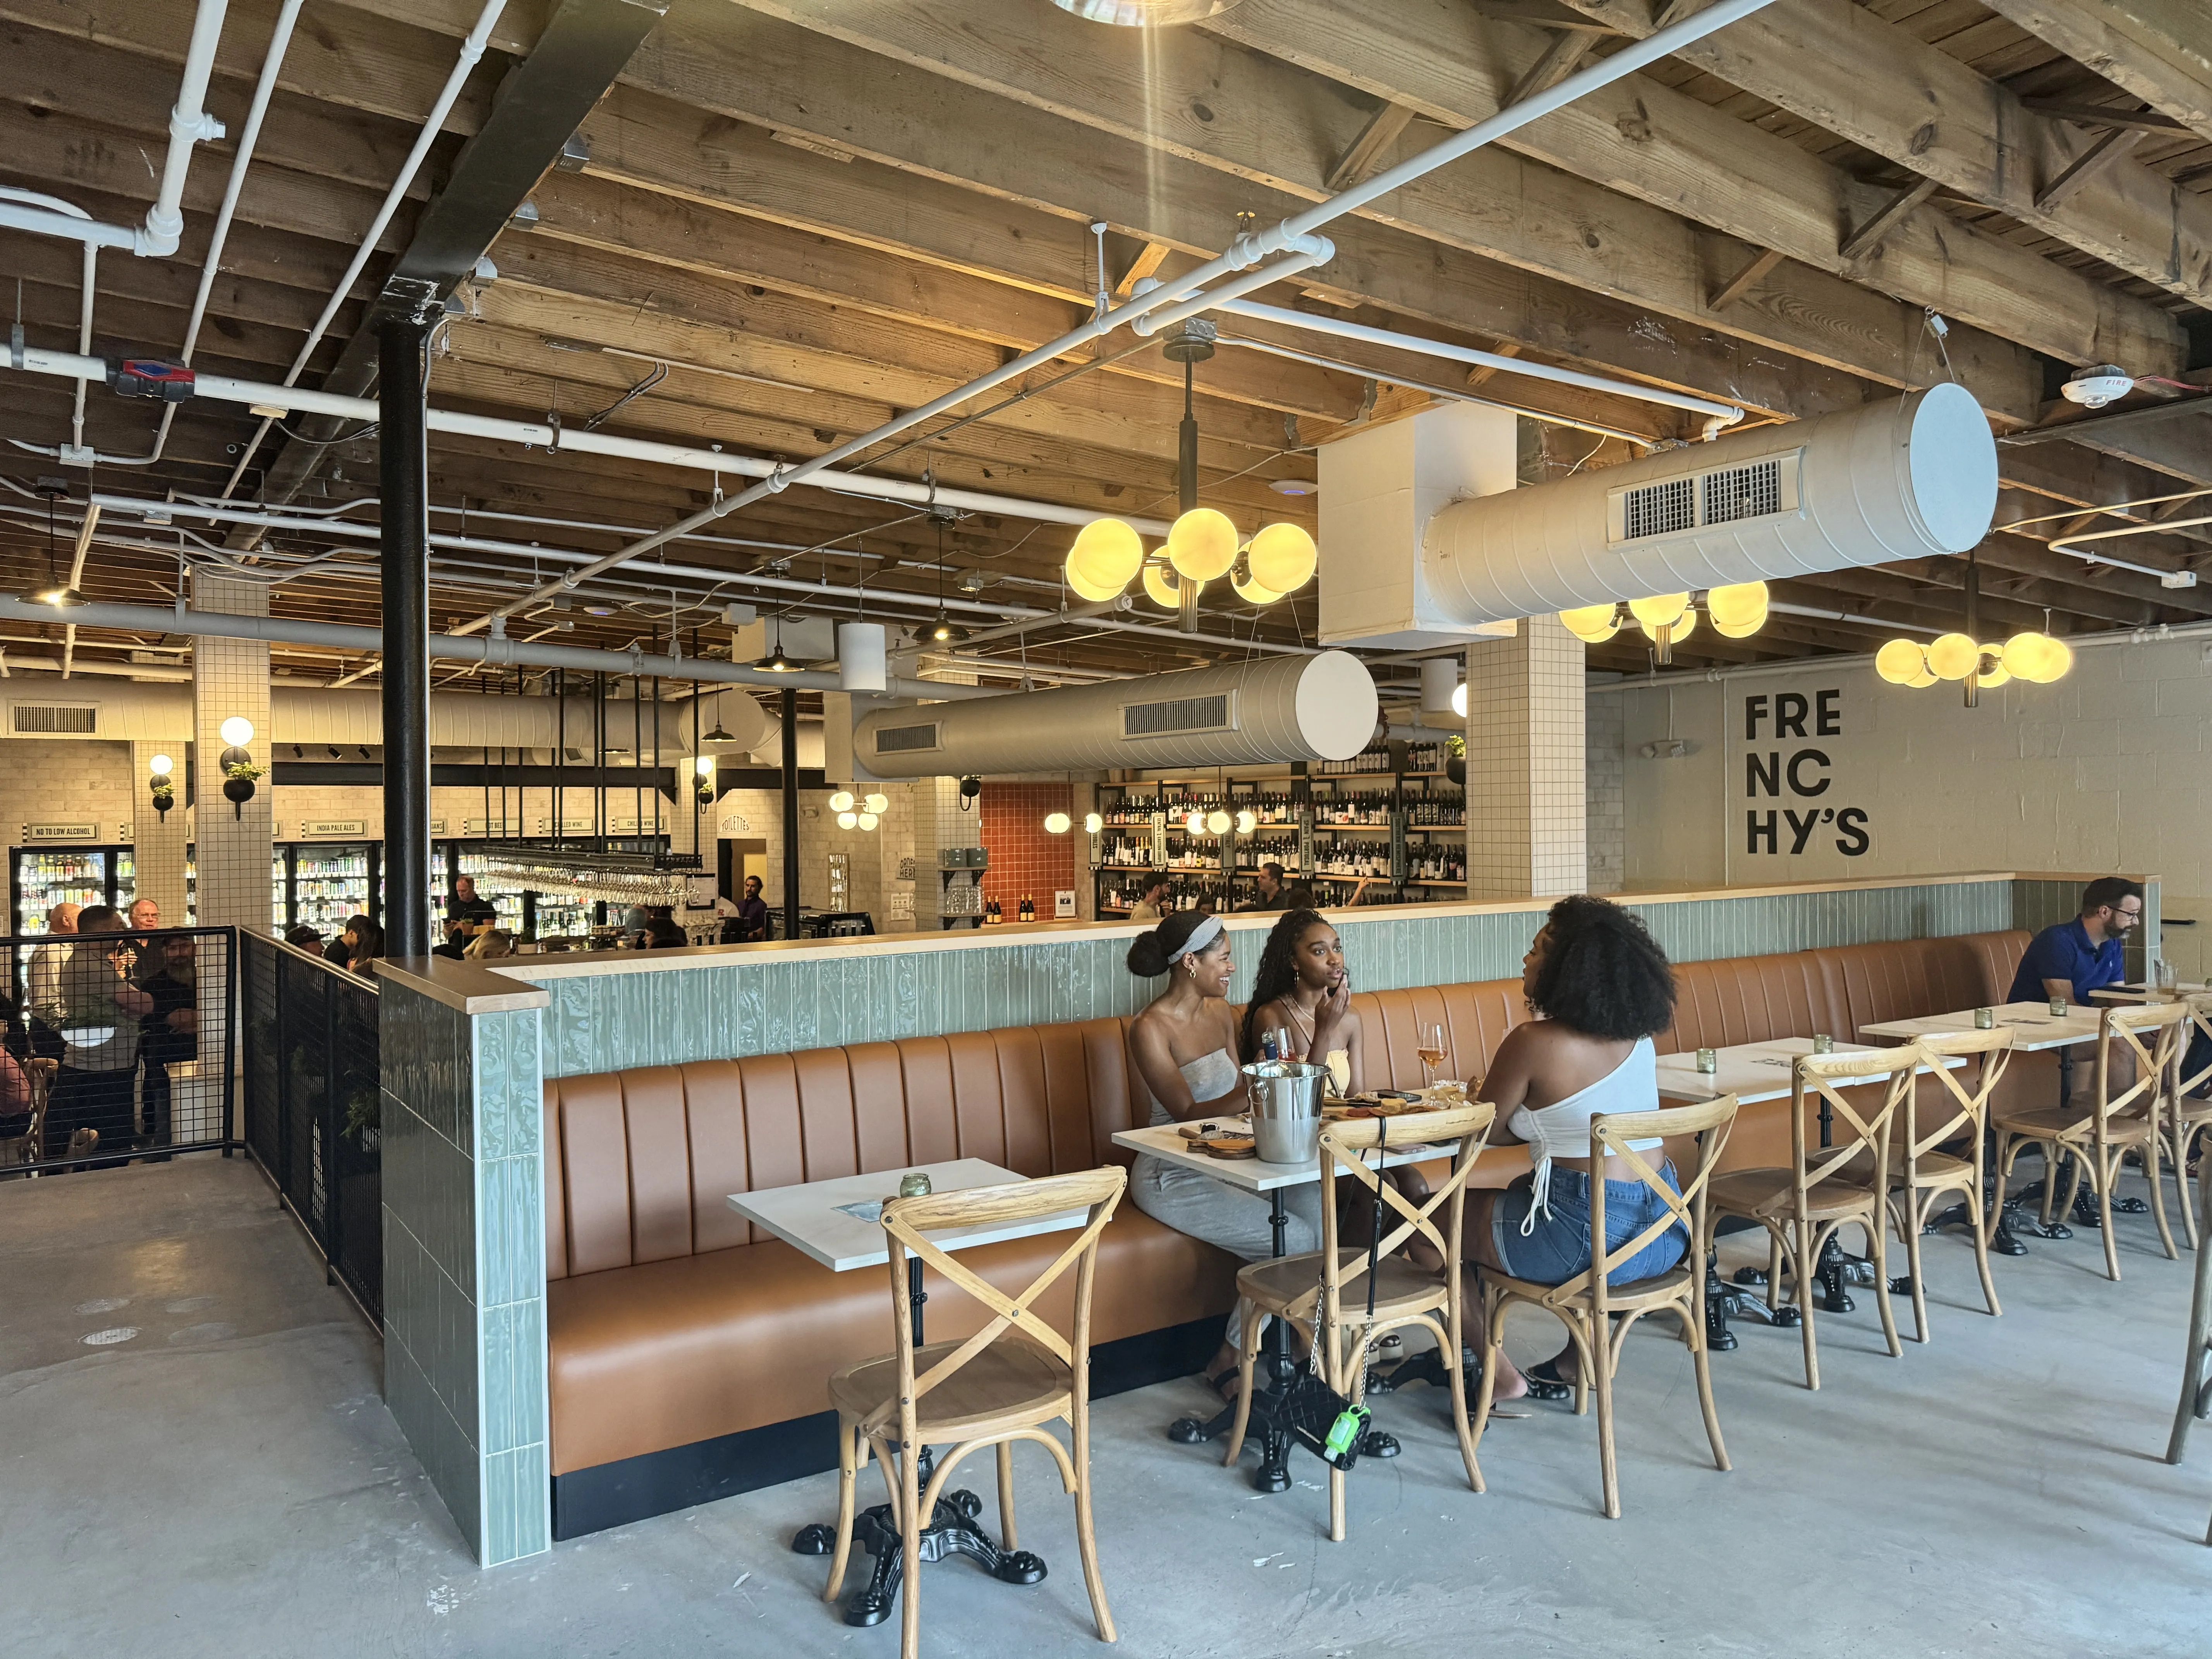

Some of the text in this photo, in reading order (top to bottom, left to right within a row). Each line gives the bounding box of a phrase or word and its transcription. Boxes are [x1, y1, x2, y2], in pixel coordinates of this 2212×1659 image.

[1746, 689, 1841, 740] FRE
[1746, 749, 1831, 797] NC
[722, 816, 749, 830] TOILETTES
[1747, 807, 1870, 856] HY'S
